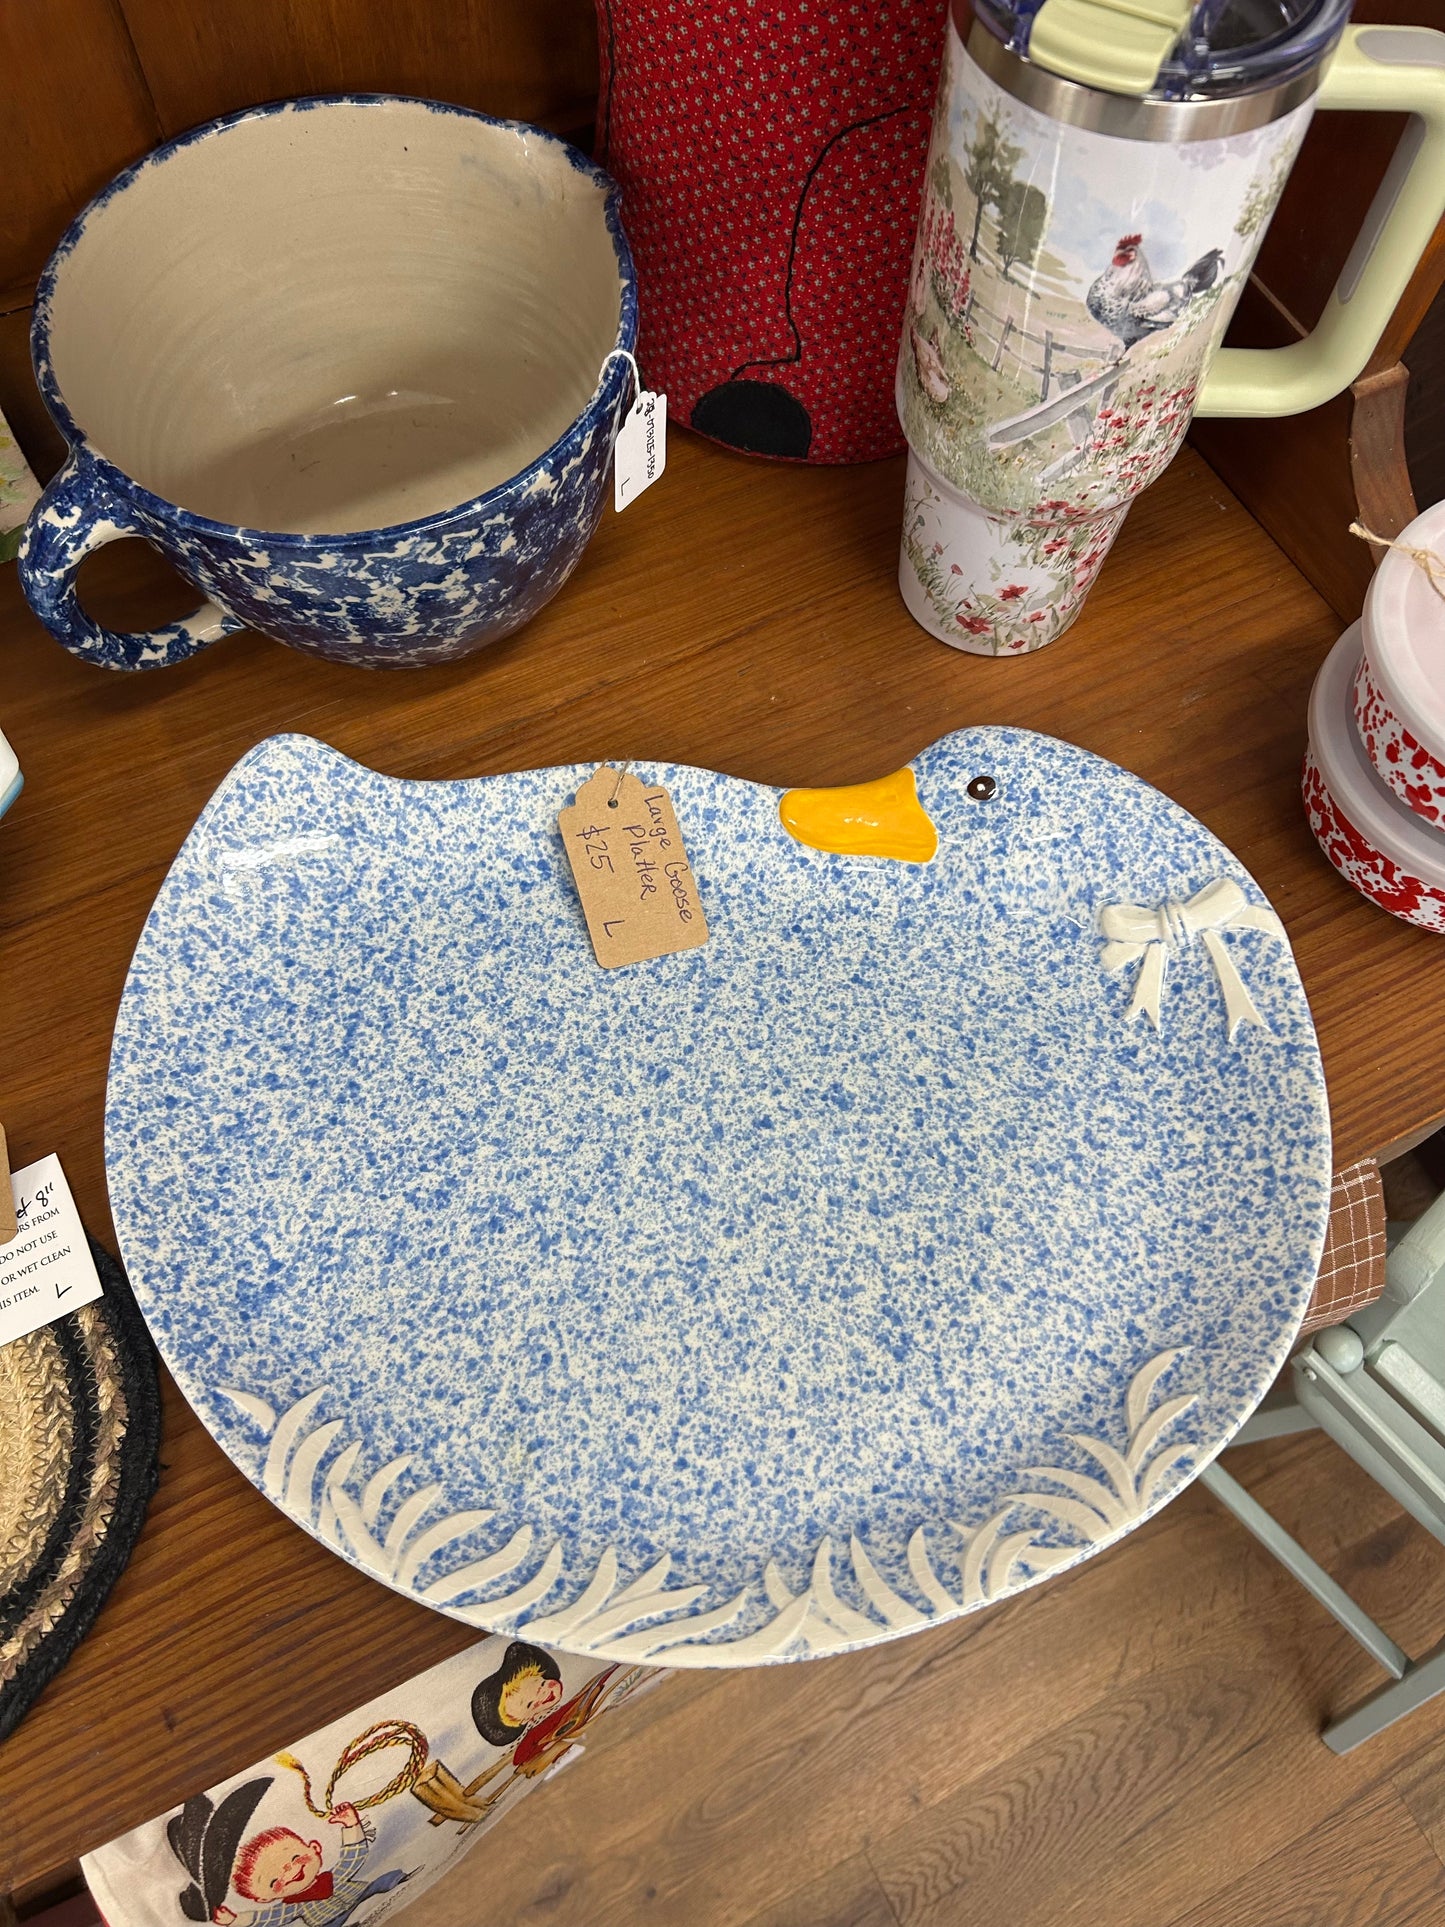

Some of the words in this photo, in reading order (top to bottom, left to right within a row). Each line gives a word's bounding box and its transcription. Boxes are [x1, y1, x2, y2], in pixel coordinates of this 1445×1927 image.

[576, 825, 615, 873] $25
[644, 795, 671, 850] Large
[664, 861, 693, 923] Goose
[603, 920, 625, 938] L
[32, 1207, 60, 1227] FROM
[0, 1251, 14, 1265] DO
[16, 1240, 37, 1255] NOT
[39, 1230, 58, 1245] USE
[1, 1273, 17, 1286] OR
[17, 1261, 39, 1276] WET
[40, 1246, 71, 1266] CLEAN
[13, 1285, 40, 1303] ITEM.
